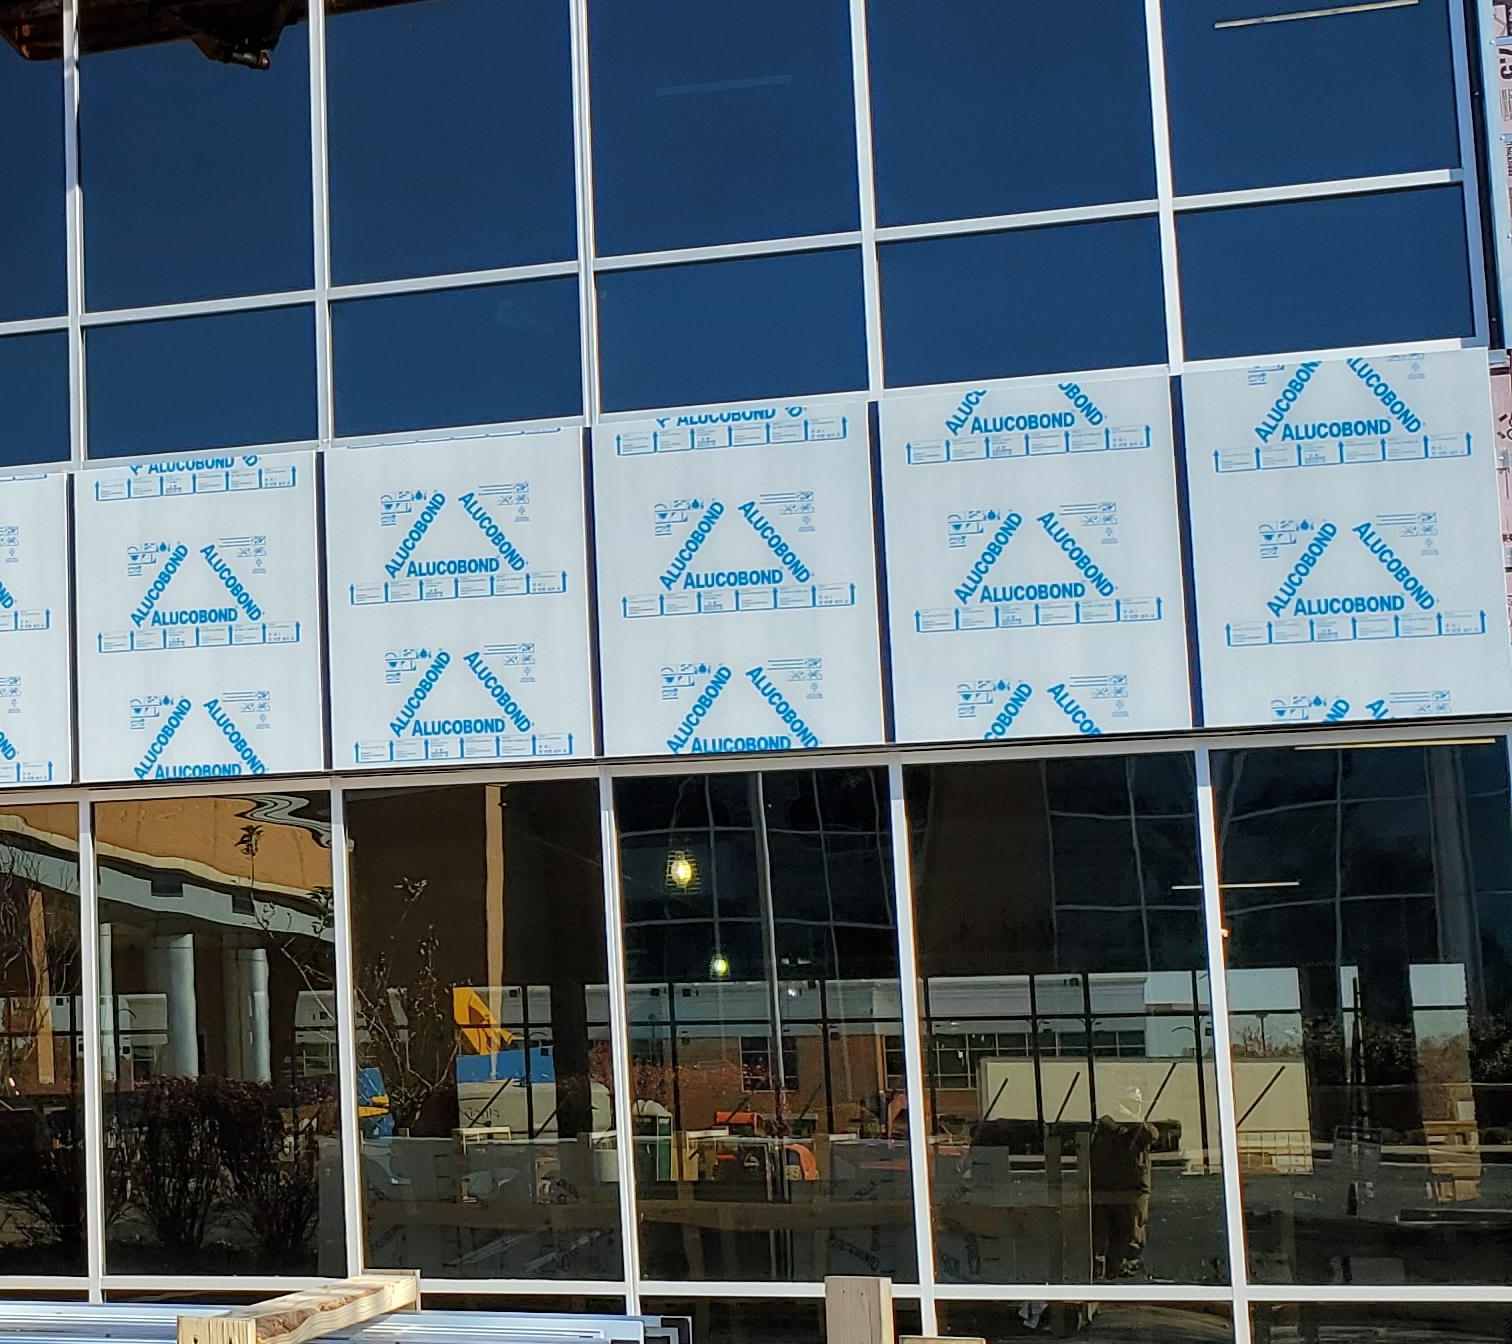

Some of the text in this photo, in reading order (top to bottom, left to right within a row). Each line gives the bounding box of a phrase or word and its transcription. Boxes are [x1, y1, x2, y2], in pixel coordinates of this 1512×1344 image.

[971, 412, 1075, 433] ALUCOBOND
[1282, 419, 1391, 440] ALUCOBOND
[385, 493, 445, 578] ALUCOBOND
[407, 558, 499, 577] ALUCOBOND
[459, 493, 524, 571] ALUCOBOND
[661, 502, 724, 590] ALUCOBOND
[739, 502, 810, 582] ALUCOBOND
[955, 513, 1022, 604] ALUCOBOND
[1038, 513, 1114, 596] ALUCOBOND
[1268, 523, 1336, 617] ALUCOBOND
[1353, 524, 1434, 609] ALUCOBOND
[131, 545, 188, 626] ALUCOBOND
[152, 608, 237, 626] ALUCOBOND
[201, 545, 261, 620] ALUCOBOND
[684, 569, 783, 589] ALUCOBOND
[981, 583, 1085, 602] ALUCOBOND
[1294, 595, 1404, 615] ALUCOBOND
[390, 652, 450, 736] ALUCOBOND
[412, 719, 505, 736] ALUCOBOND
[464, 652, 530, 732] ALUCOBOND
[667, 667, 731, 754] ALUCOBOND
[134, 699, 191, 780] ALUCOBOND
[156, 764, 243, 781] ALUCOBOND
[692, 736, 791, 756] ALUCOBOND
